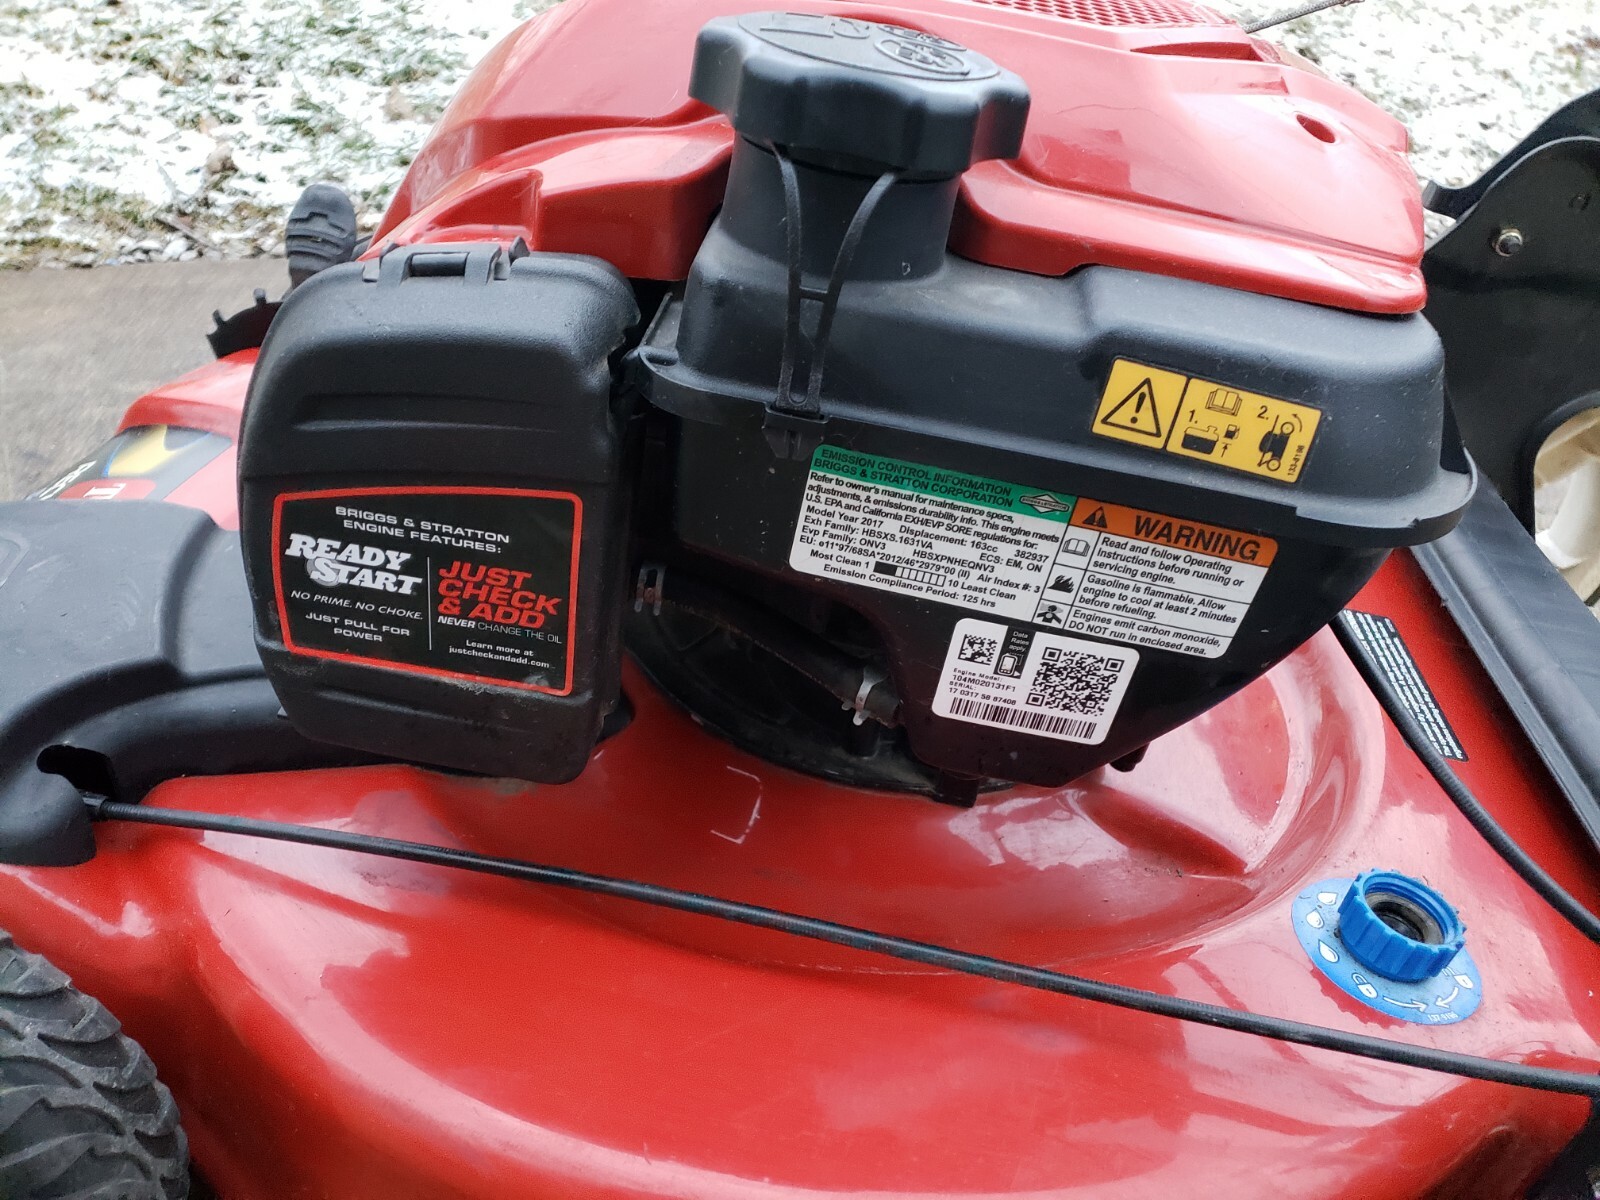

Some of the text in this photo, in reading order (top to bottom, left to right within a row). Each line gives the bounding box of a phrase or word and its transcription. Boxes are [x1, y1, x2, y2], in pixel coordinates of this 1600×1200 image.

[813, 457, 1014, 507] BRIGGS & STRATTON CORPORATION
[821, 448, 1012, 497] EMISSION CONTROL INFORMATION
[810, 471, 1014, 524] Refer to owner's manual for maintenance specs,
[336, 506, 510, 544] BRIGGS & STRATTON
[805, 492, 1038, 549] U.S. EPA and California EXH/EVP SORE regulations for:
[806, 504, 883, 528] Model Year 2017
[807, 484, 1059, 543] adjustments, & emissions durability info. This engine meets
[344, 520, 502, 553] ENGINE FEATURES:
[799, 535, 816, 545] EU:
[802, 525, 820, 537] Evp
[822, 529, 856, 544] Family:
[804, 515, 932, 550] Exh Family: HBSXS.1631VA
[899, 525, 998, 552] Displacement: 163cc
[1134, 514, 1260, 561] WARNING
[285, 533, 411, 572] READY
[810, 549, 833, 561] Most
[835, 555, 861, 567] Clean
[979, 552, 1043, 572] ECS: EM, ON
[1014, 549, 1049, 563] 382937
[1097, 547, 1156, 568] Instructions
[1158, 561, 1190, 575] before
[1192, 570, 1231, 586] running
[1101, 536, 1232, 575] Read and follow Operating
[310, 556, 422, 596] START
[439, 560, 532, 589] JUST
[823, 563, 996, 607] Emission Compliance Period: 125 hrs
[976, 574, 1040, 593] Air Index #: 3
[1093, 560, 1175, 584] servicing engine.
[438, 578, 562, 615] CHECK
[948, 579, 1016, 600] 10 Least Clean
[1087, 574, 1226, 610] Gasoline is flammable. Allow
[290, 591, 423, 620] NO PRIME. NO CHOKE.
[438, 598, 545, 629] & ADD
[1078, 594, 1156, 619] before refueling.
[1082, 586, 1237, 623] engine to cool at least 2 minutes
[305, 612, 410, 636] JUST PULL FOR
[334, 628, 382, 642] POWER
[438, 615, 562, 644] NEVER CHANGE THE OIL
[1072, 609, 1112, 624] Engines
[1114, 620, 1136, 629] emit
[1137, 625, 1171, 636] carbon
[466, 639, 534, 656] Learn more at
[1011, 637, 1029, 645] Rates
[1068, 620, 1206, 655] DO NOT run in enclosed area.
[449, 645, 550, 669] justcheckandadd.com
[949, 681, 977, 690] SERIAL:
[953, 668, 1002, 681] Engine Model:
[959, 689, 979, 698] 0317
